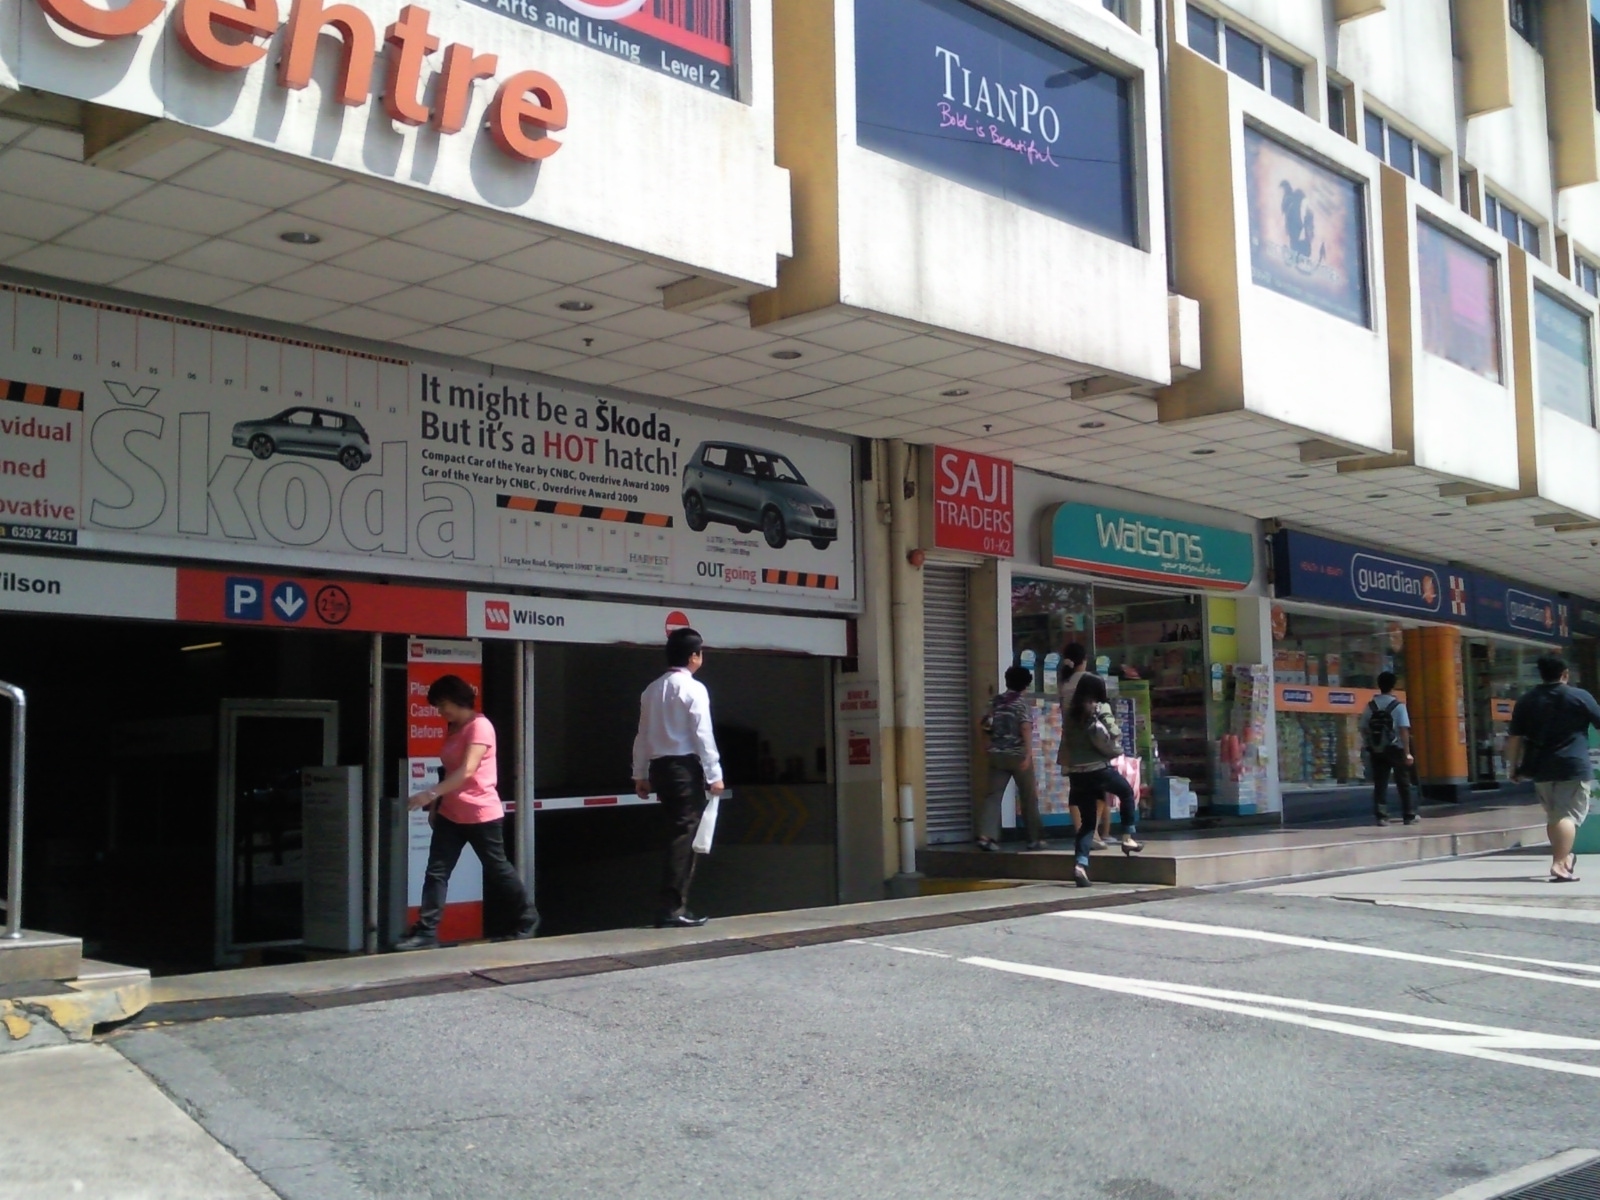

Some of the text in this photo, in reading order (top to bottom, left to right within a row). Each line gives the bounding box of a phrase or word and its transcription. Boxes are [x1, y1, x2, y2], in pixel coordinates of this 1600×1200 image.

[545, 11, 580, 38] and
[586, 21, 641, 64] Living
[660, 50, 704, 84] Level
[709, 69, 720, 90] 2
[937, 102, 1060, 168] Bold is Beautiful
[421, 373, 441, 404] It
[449, 383, 530, 422] might
[537, 391, 568, 426] be
[574, 407, 588, 429] a
[421, 410, 678, 478] But it's a HOT hatch!
[89, 380, 475, 560] Škoda
[421, 448, 670, 493] Compact Car of the Year by CNBC, Overdrive Award 2009
[421, 465, 440, 477] Car
[441, 468, 452, 479] of
[453, 469, 470, 481] the
[472, 472, 494, 485] Year
[495, 475, 508, 489] by
[542, 482, 587, 498] Overdrive
[588, 488, 616, 501] Award
[617, 492, 638, 504] 2009
[940, 453, 1007, 505] SAJI
[11, 525, 42, 540] 6292
[44, 528, 74, 543] 4251
[936, 499, 1012, 535] TRADERS
[983, 535, 1011, 554] 01-K2
[1095, 512, 1204, 563] Watsons
[0, 572, 61, 595] ilson
[696, 560, 757, 585] OUTgoing
[1358, 568, 1422, 596] guardian
[233, 584, 257, 614] P
[513, 609, 565, 627] Wilson
[425, 647, 452, 656] Wilson
[410, 725, 444, 739] Before
